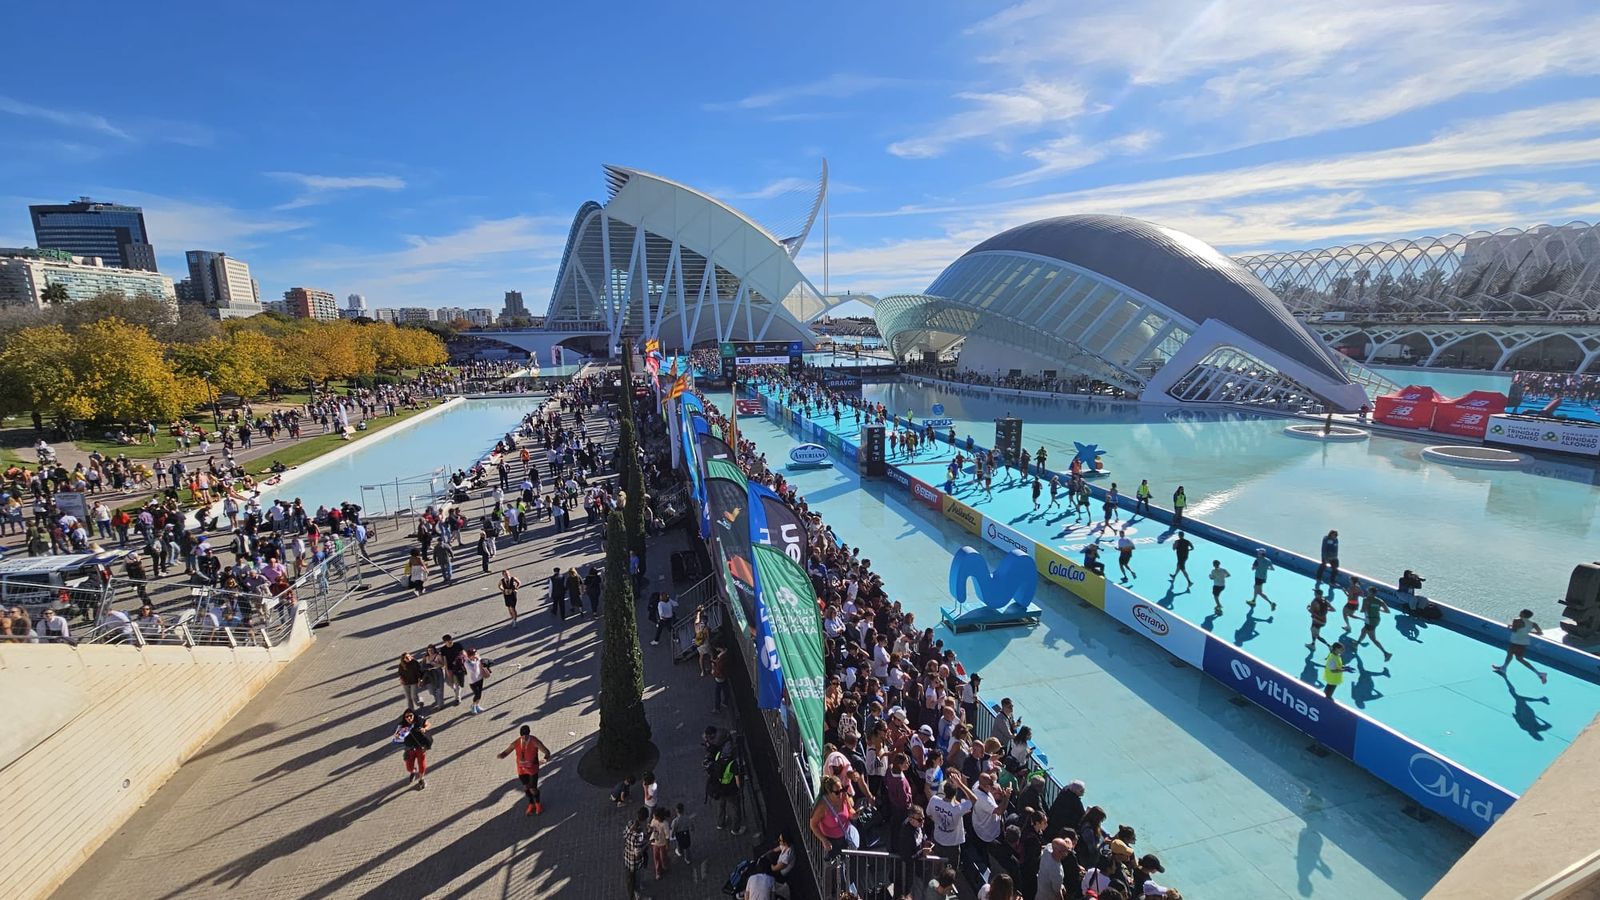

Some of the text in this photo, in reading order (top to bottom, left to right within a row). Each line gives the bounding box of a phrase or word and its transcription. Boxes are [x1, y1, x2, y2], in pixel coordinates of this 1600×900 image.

[1507, 428, 1540, 437] TRINIDAD
[1562, 435, 1598, 444] TRINIDAD
[997, 532, 1028, 554] COROS
[1048, 560, 1086, 582] ColaCao
[1136, 607, 1166, 632] Serrano
[1254, 675, 1320, 722] vithas
